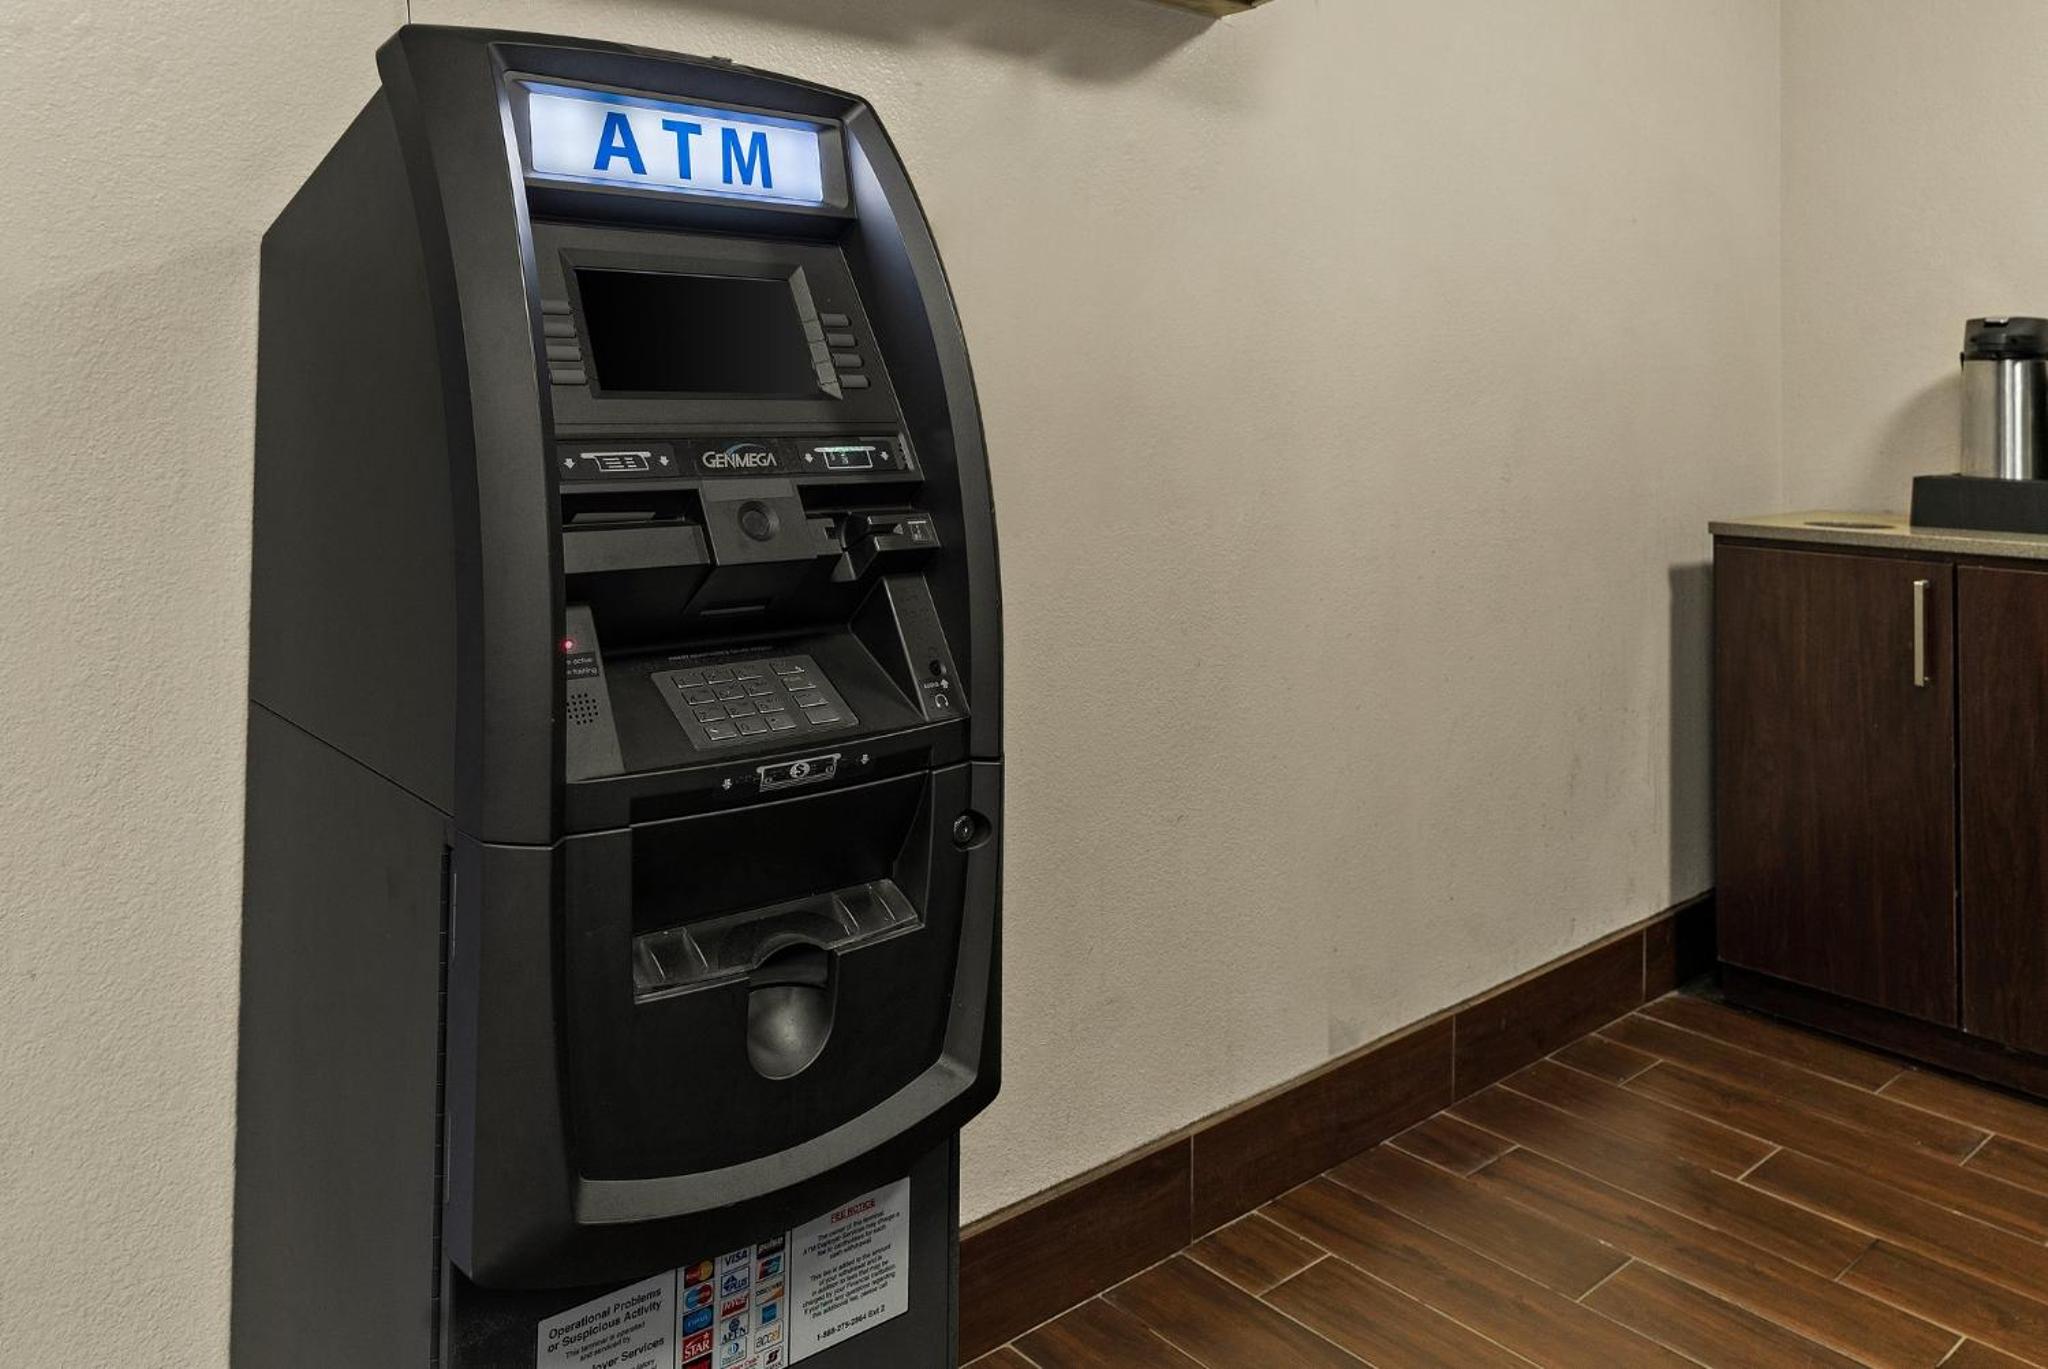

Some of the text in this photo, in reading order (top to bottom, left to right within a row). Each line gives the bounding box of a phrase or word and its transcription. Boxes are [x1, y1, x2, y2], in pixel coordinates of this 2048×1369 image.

[593, 110, 773, 189] ATM
[702, 451, 778, 469] GENMEGA
[724, 1250, 748, 1266] VISA
[547, 1341, 560, 1353] or
[562, 1317, 621, 1347] Suspicious
[623, 1300, 663, 1322] Activity
[548, 1287, 662, 1340] Operational Problems
[621, 1336, 665, 1362] Services
[684, 1339, 710, 1360] STAR
